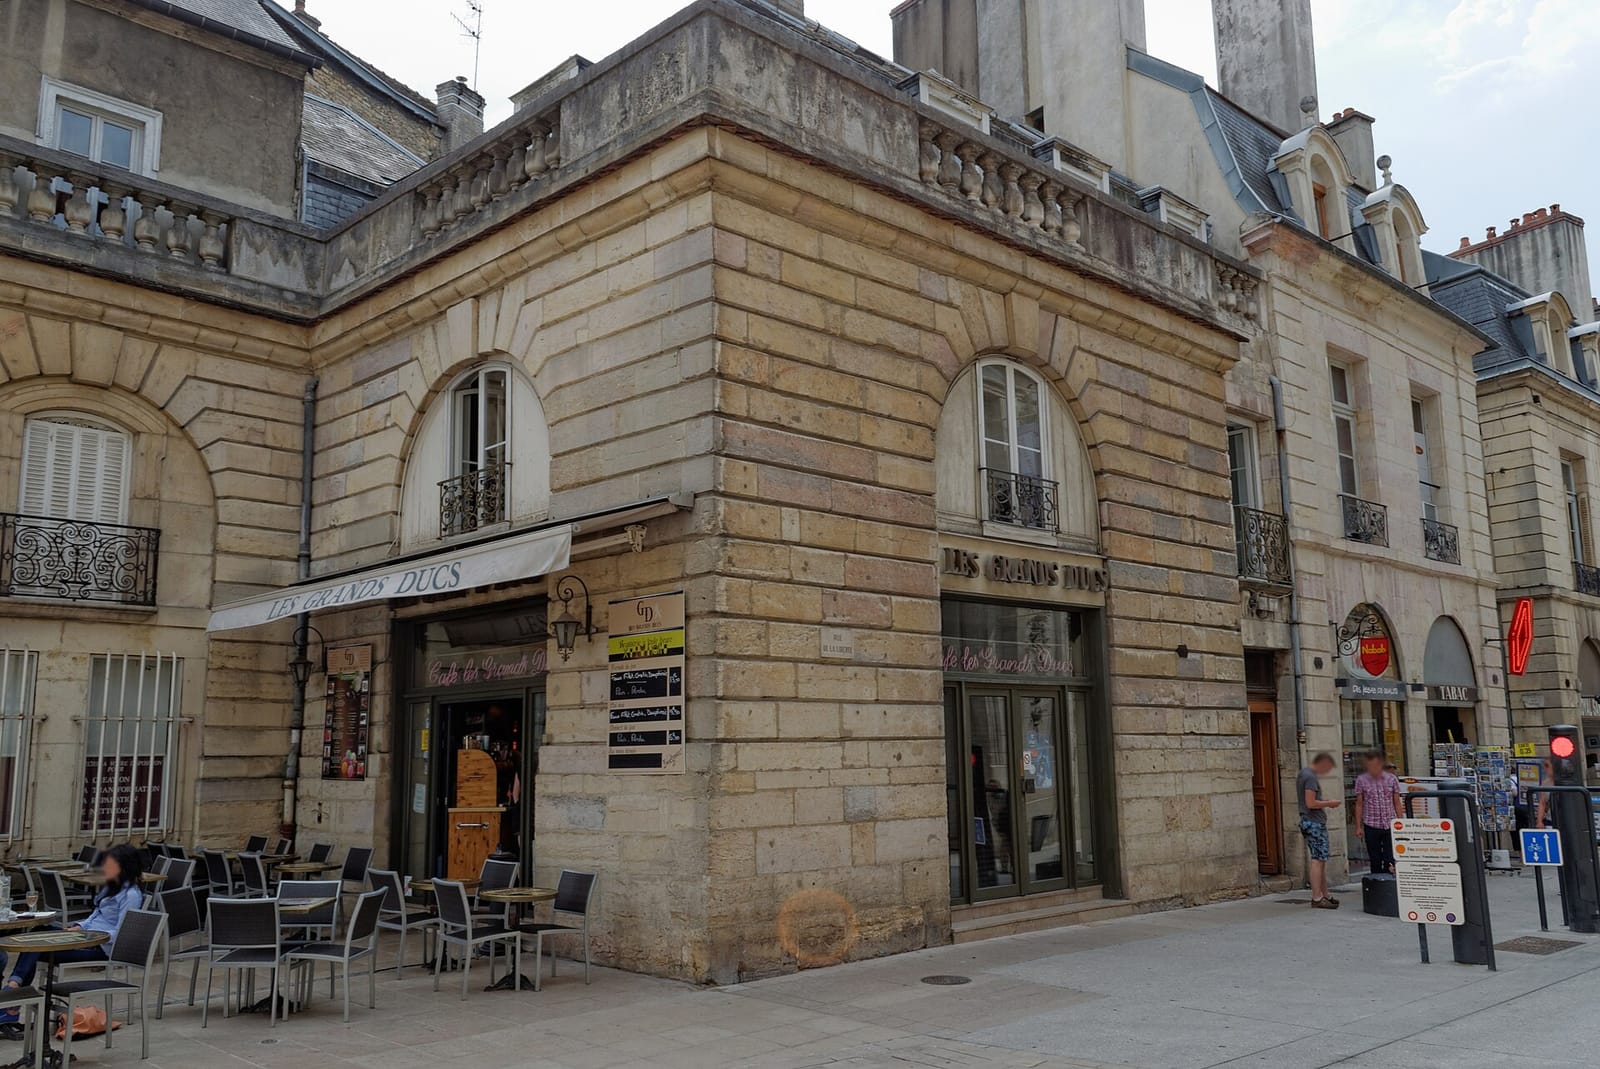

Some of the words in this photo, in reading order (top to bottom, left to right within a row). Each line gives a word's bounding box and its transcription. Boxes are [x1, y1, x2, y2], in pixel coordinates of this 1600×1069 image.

[944, 548, 979, 578] LES
[989, 555, 1059, 586] GRANDS
[1062, 565, 1110, 592] DUCS
[266, 595, 301, 620] LES
[302, 576, 390, 610] GRANDS
[394, 561, 462, 594] DUCS
[980, 646, 1034, 672] Grands
[1037, 648, 1073, 672] Ducs
[1440, 685, 1468, 701] TABAC
